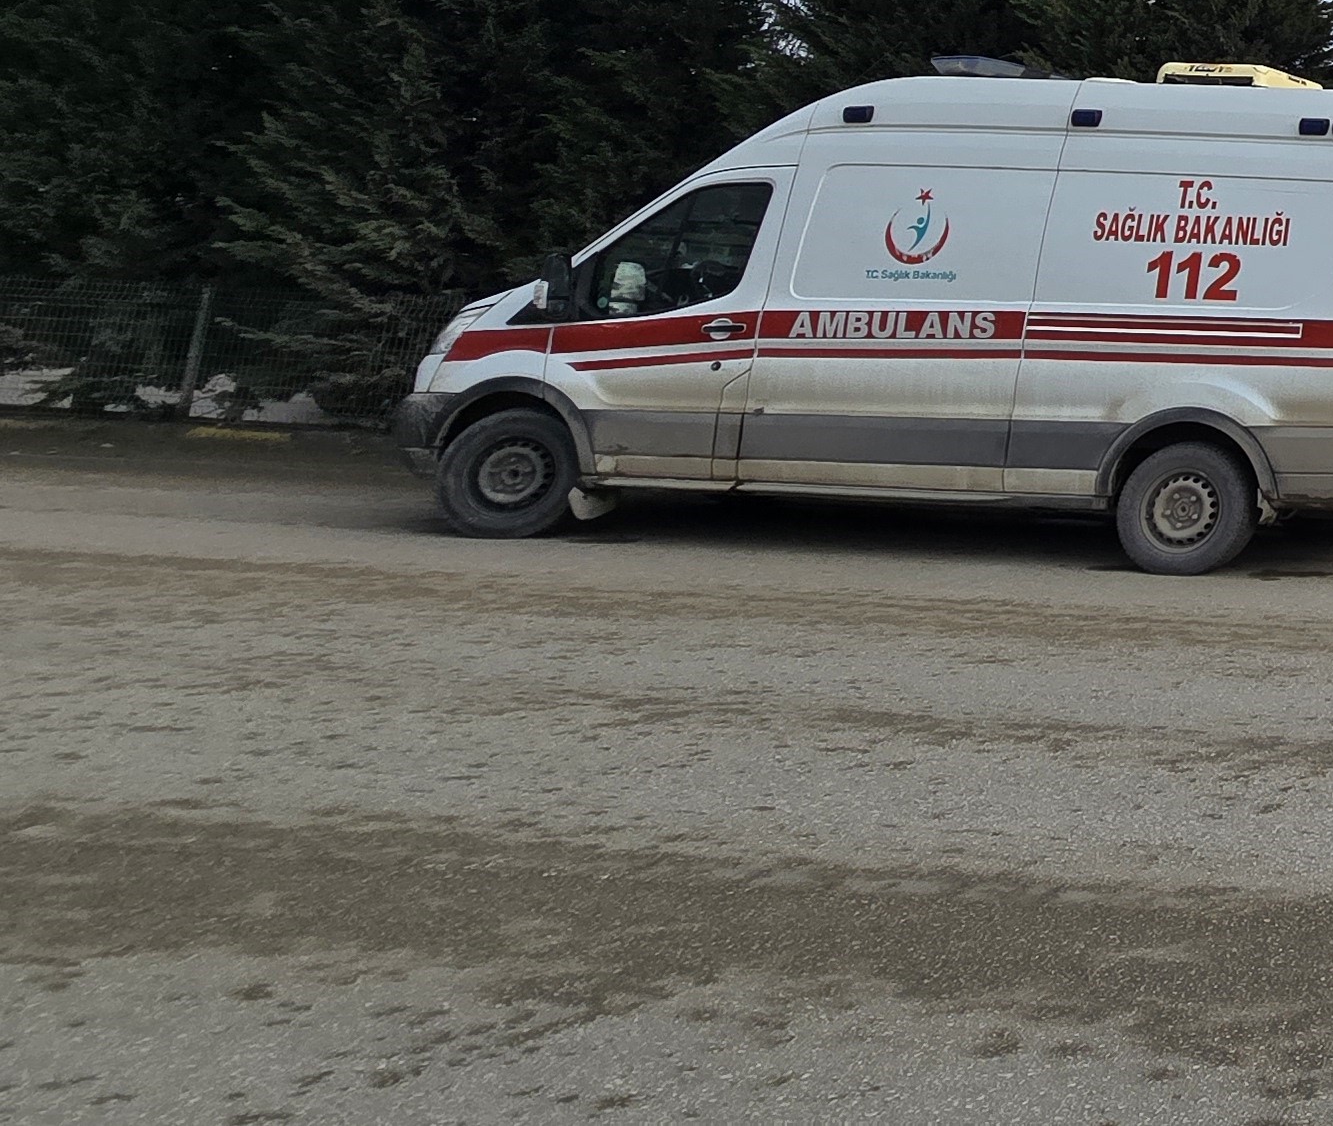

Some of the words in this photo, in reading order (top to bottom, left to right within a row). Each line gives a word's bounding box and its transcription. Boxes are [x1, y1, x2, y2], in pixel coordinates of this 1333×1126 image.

[1178, 180, 1218, 210] T.C.
[1093, 206, 1170, 243] SAĞLIK
[1173, 211, 1291, 247] BAKANLIĞI
[880, 269, 910, 282] Sağlık
[911, 270, 957, 283] Bakanlığı
[1146, 250, 1242, 301] 112
[788, 311, 996, 339] AMBULANS
